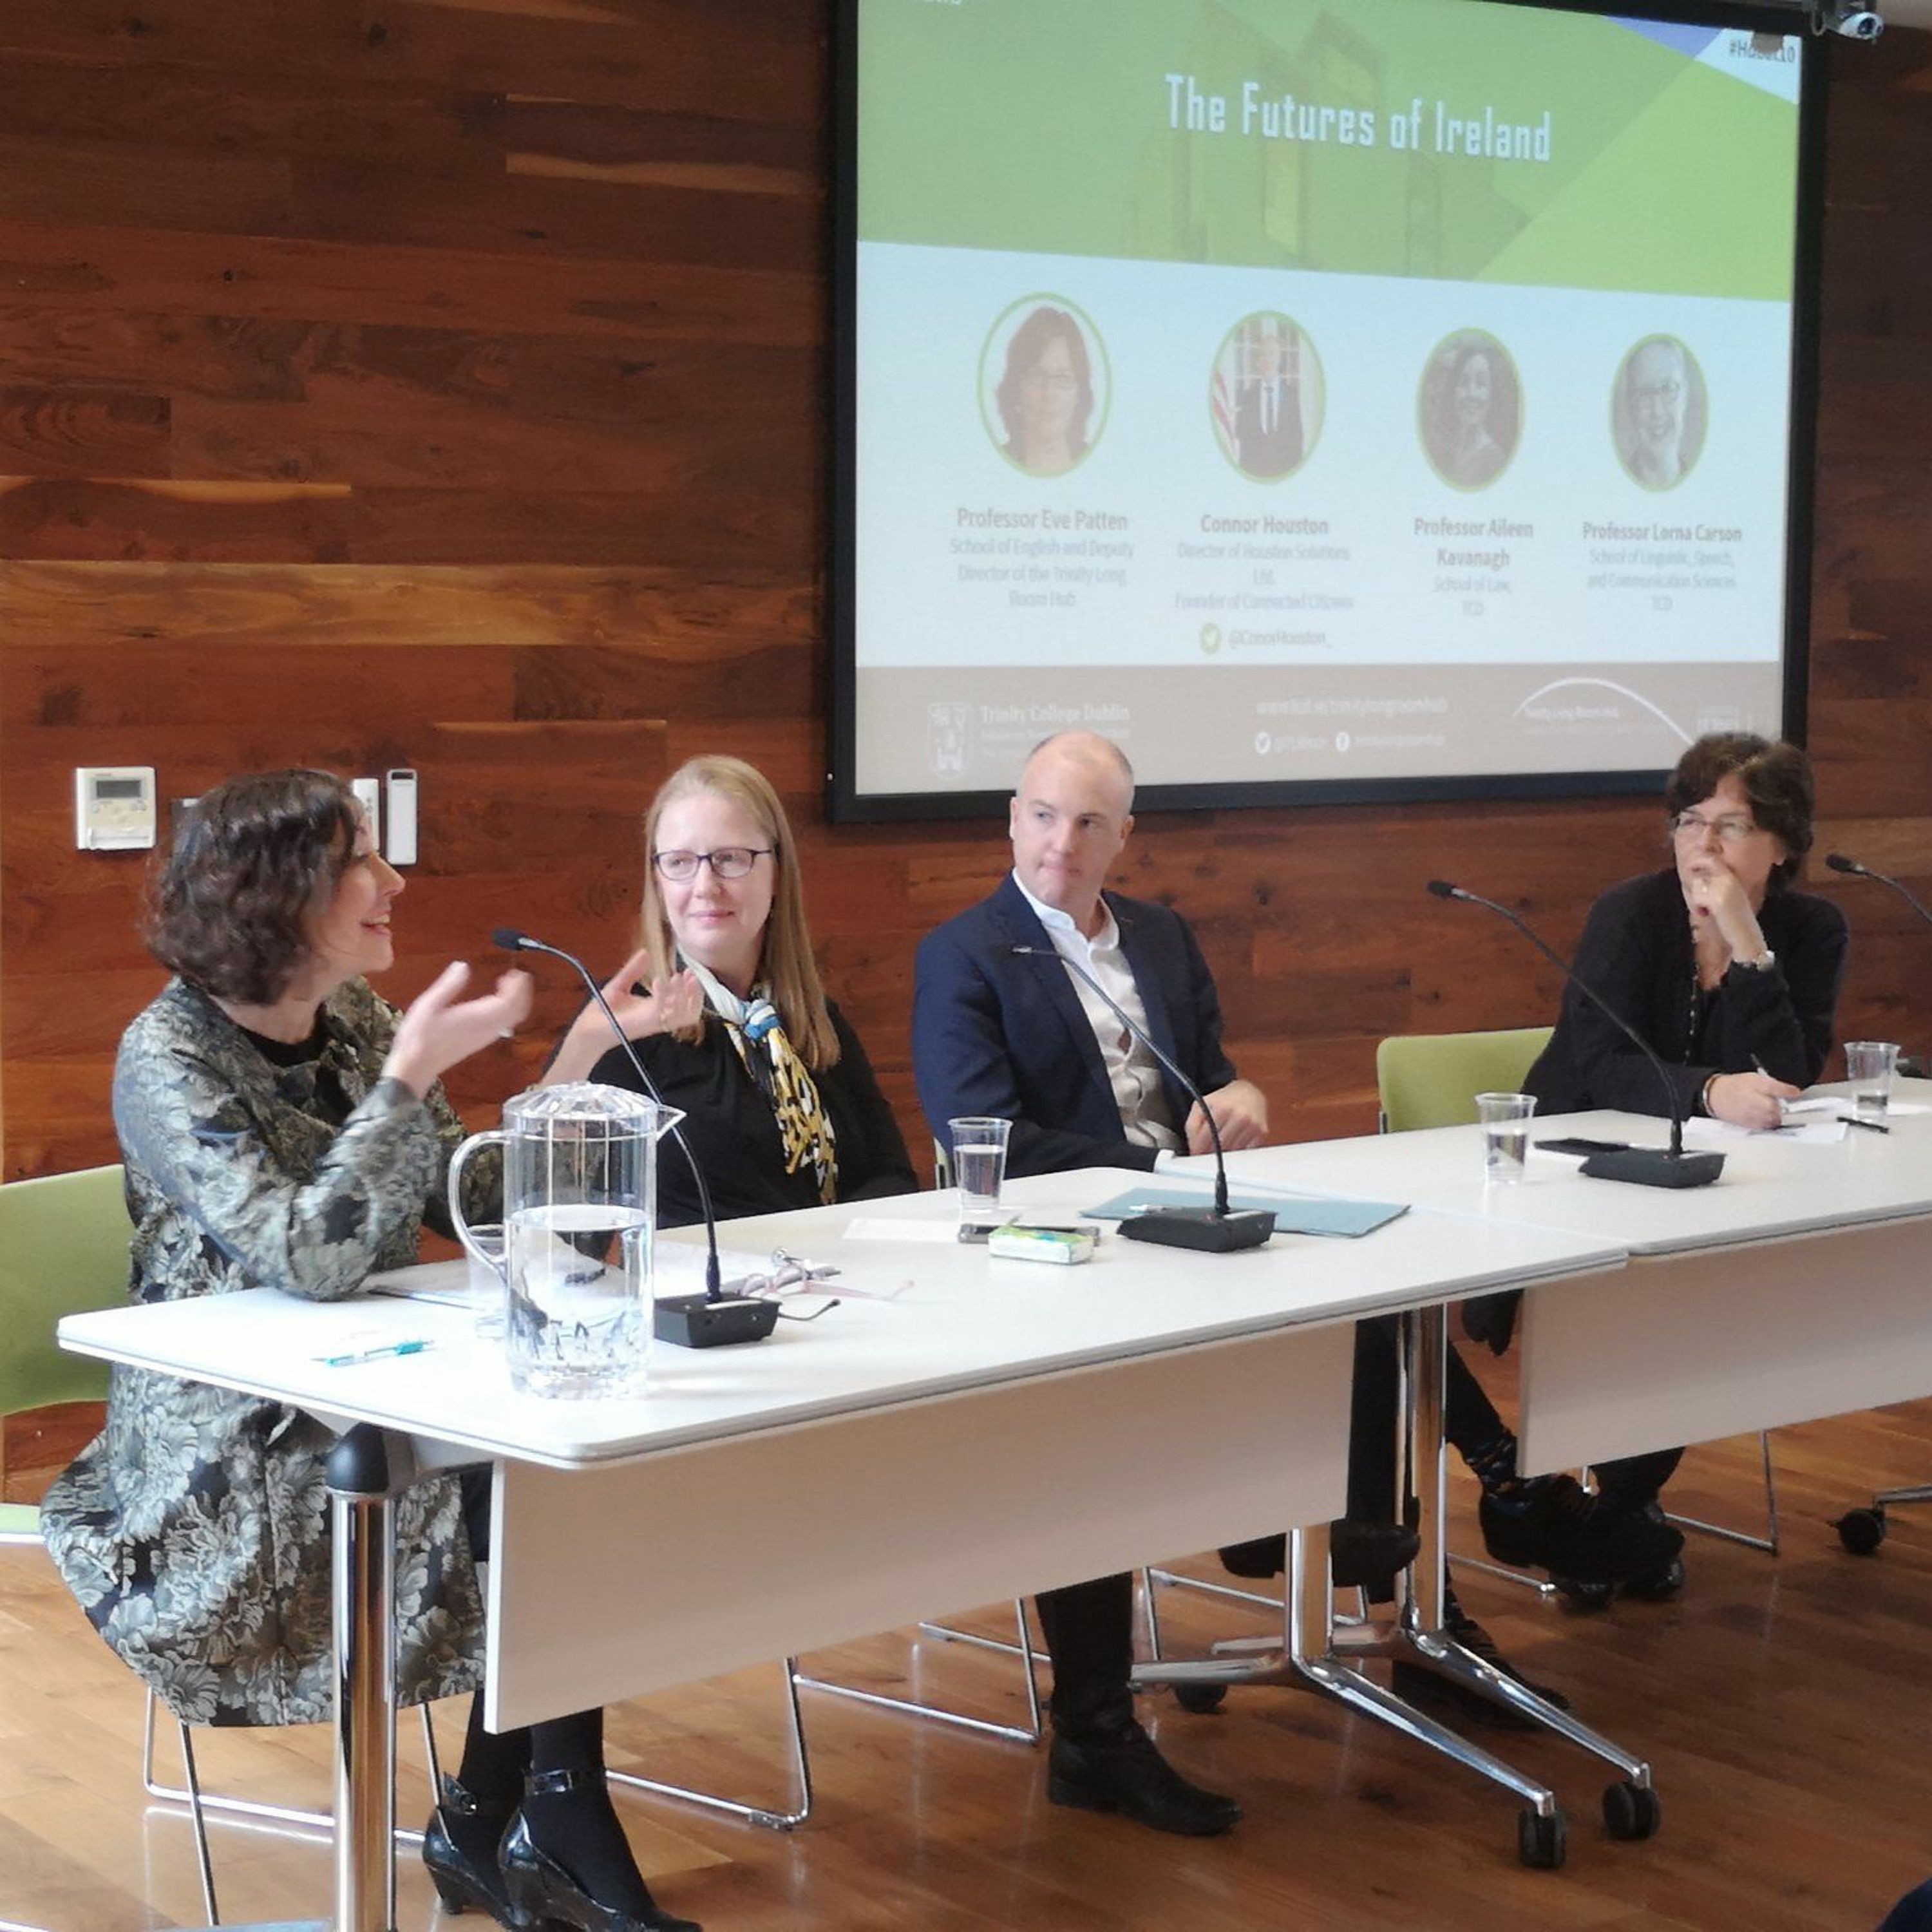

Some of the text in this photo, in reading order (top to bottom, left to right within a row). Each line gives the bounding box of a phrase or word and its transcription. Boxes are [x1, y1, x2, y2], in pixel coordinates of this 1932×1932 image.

[1166, 73, 1551, 161] The Futures of Ireland
[957, 507, 1128, 531] Professor Eve Patten
[1200, 514, 1329, 535] Connor Houston
[1414, 516, 1534, 538] Professor Aileen
[1583, 521, 1741, 542] Professor Lorna Carson
[949, 537, 1135, 559] School of English and Deputy
[1178, 542, 1226, 558] Director
[1228, 543, 1240, 558] of
[1243, 544, 1293, 559] Houston
[1437, 548, 1510, 571] Kavanagh
[958, 564, 1127, 587] Director of the Trinity Long
[1030, 705, 1080, 724] College
